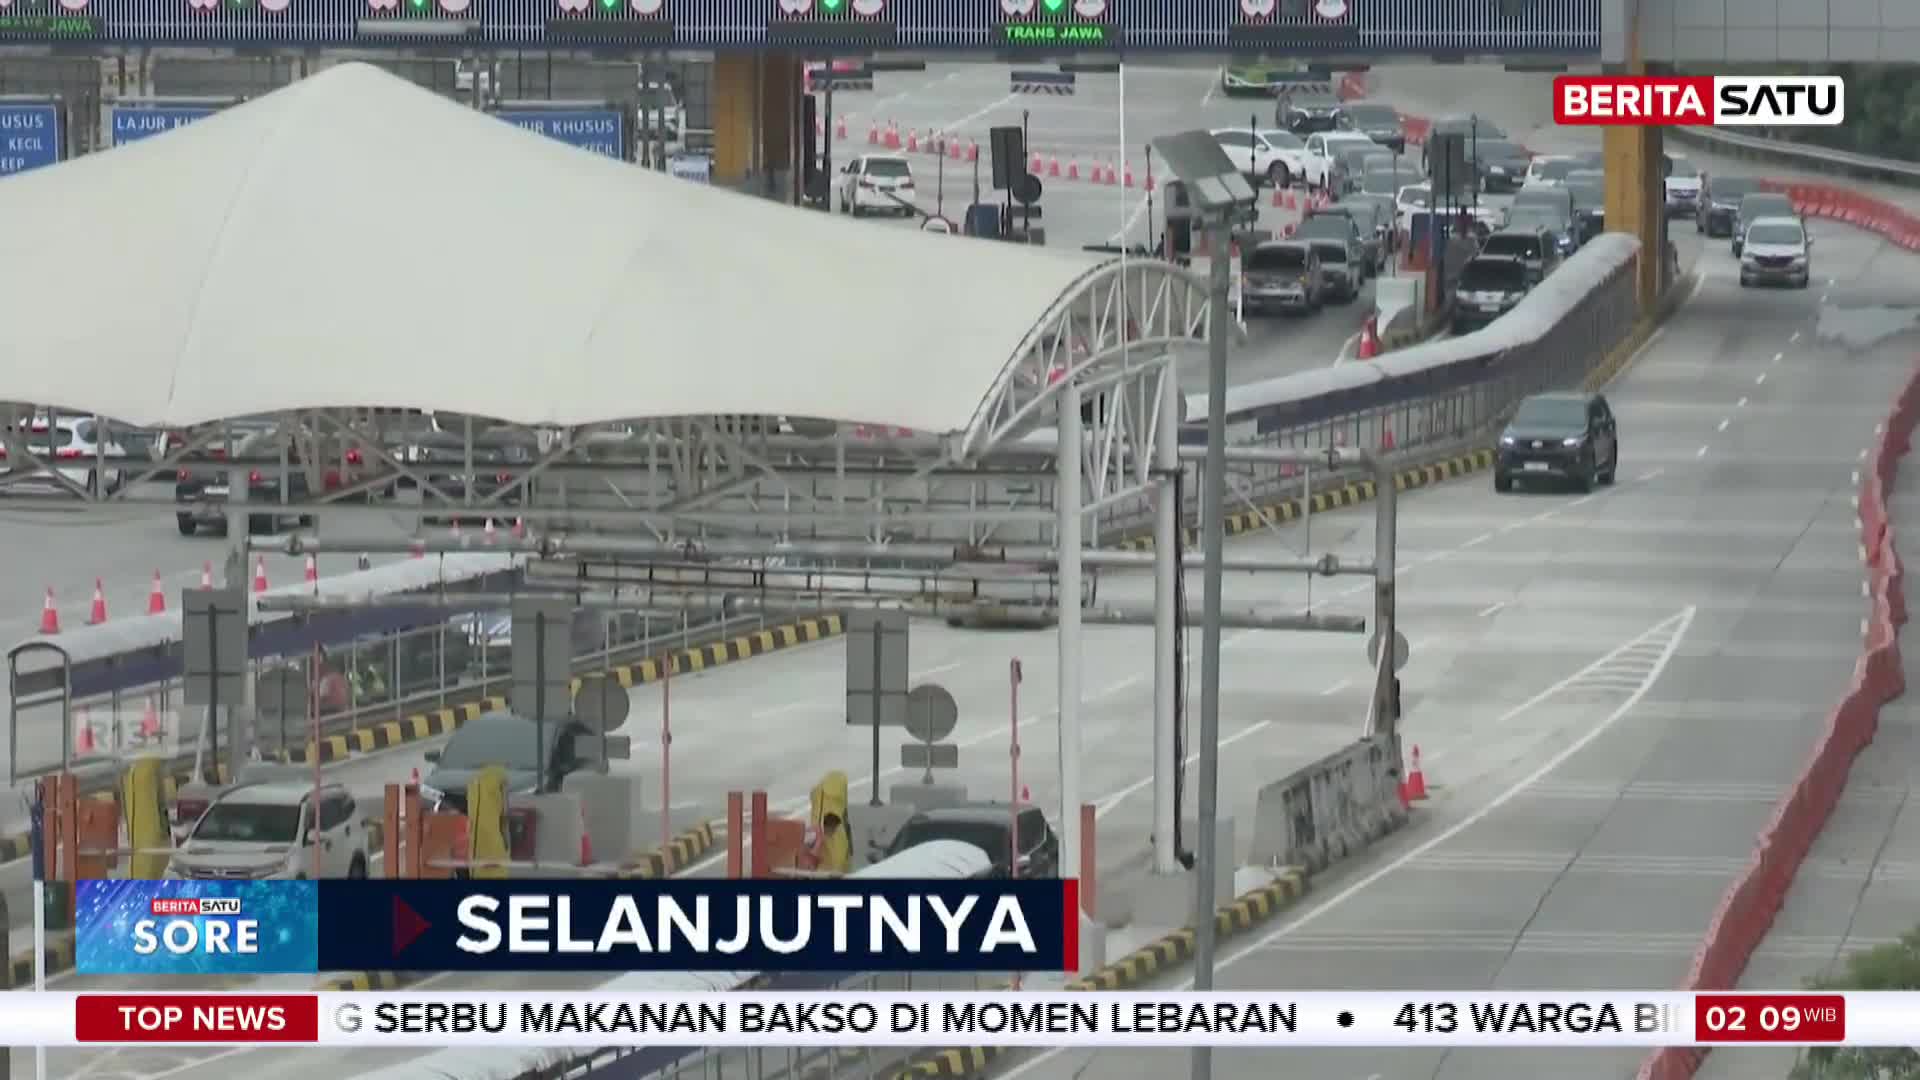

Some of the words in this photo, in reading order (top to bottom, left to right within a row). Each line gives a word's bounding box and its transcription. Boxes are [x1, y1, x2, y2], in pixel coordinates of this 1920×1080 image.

[1005, 26, 1056, 39] TRANS
[1060, 26, 1104, 39] JAWA
[0, 114, 43, 129] USUS
[117, 116, 166, 130] LAJUR
[553, 120, 614, 134] KHUSUS
[8, 137, 43, 152] KECIL
[0, 157, 25, 171] EEP
